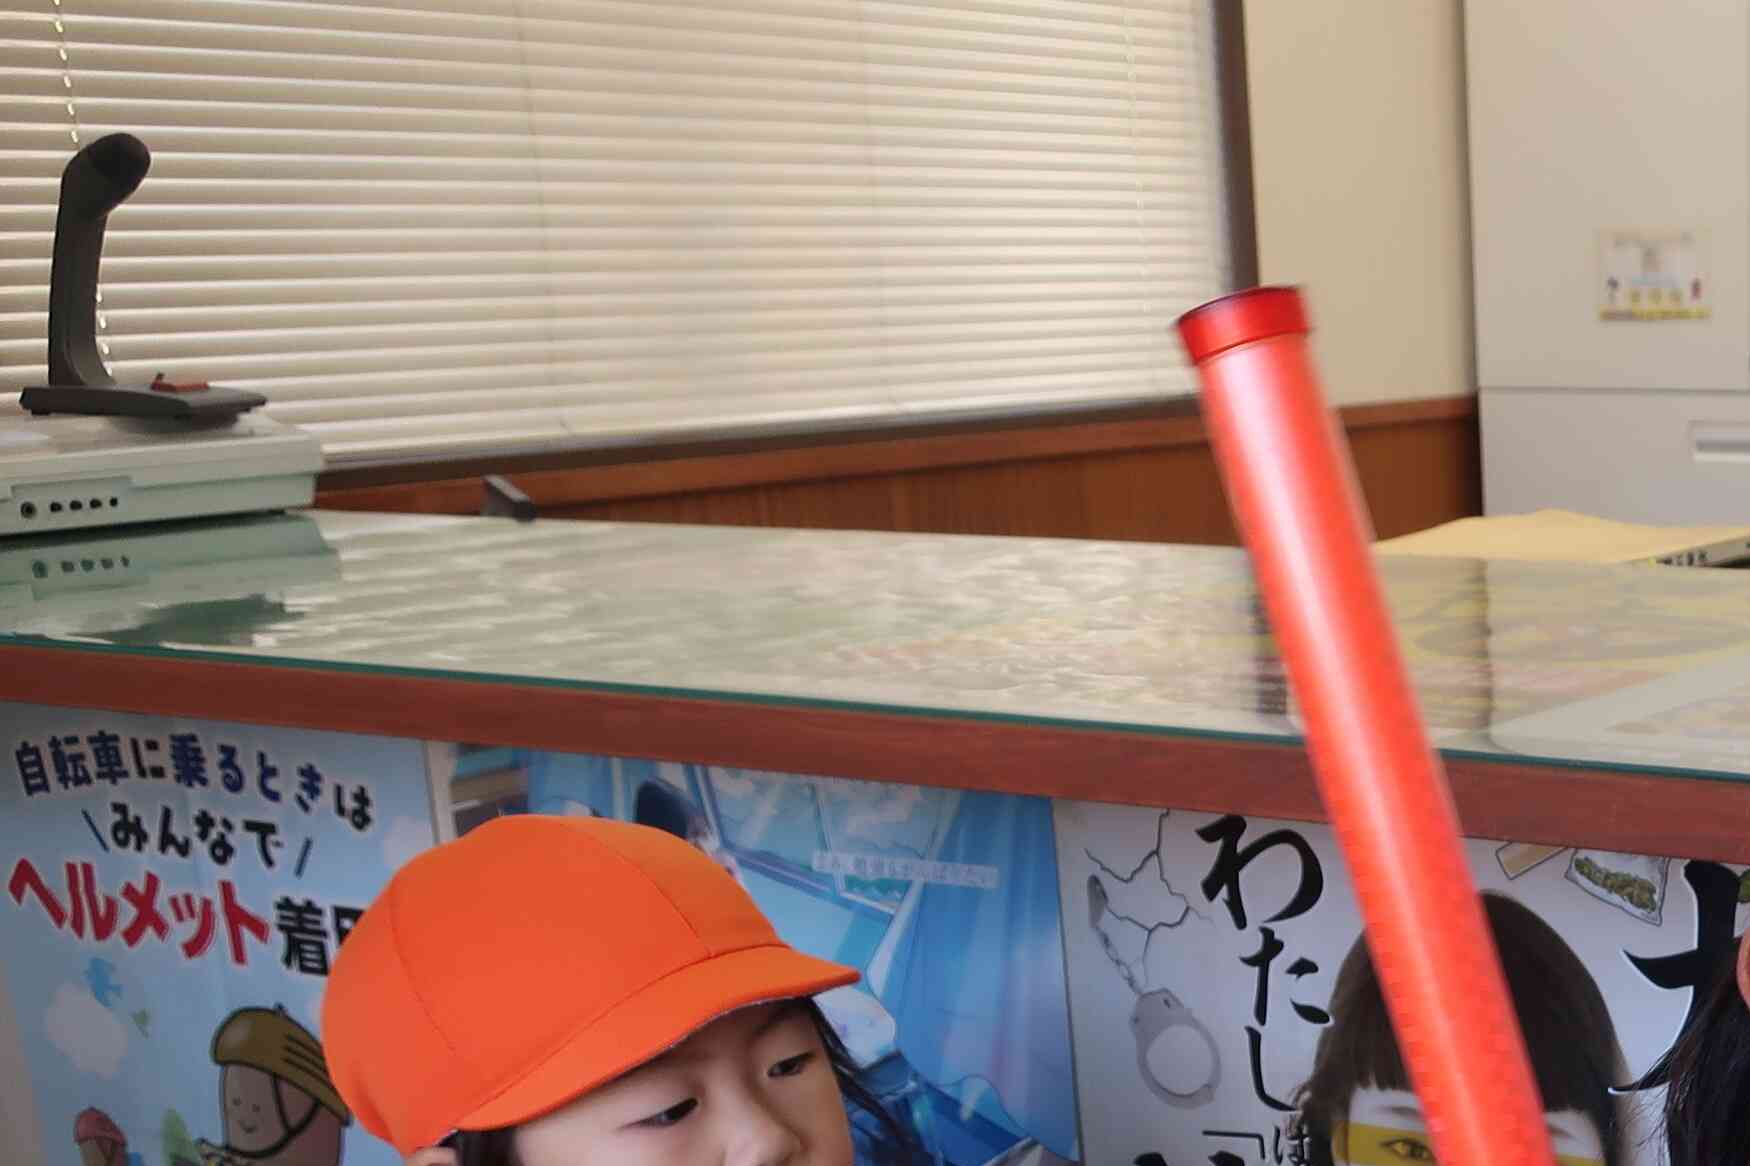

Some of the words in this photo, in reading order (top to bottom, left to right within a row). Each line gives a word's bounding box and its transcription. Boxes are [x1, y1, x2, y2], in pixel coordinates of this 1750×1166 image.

[14, 731, 373, 832] 自転車に乗るときは
[109, 801, 284, 869] みんなで
